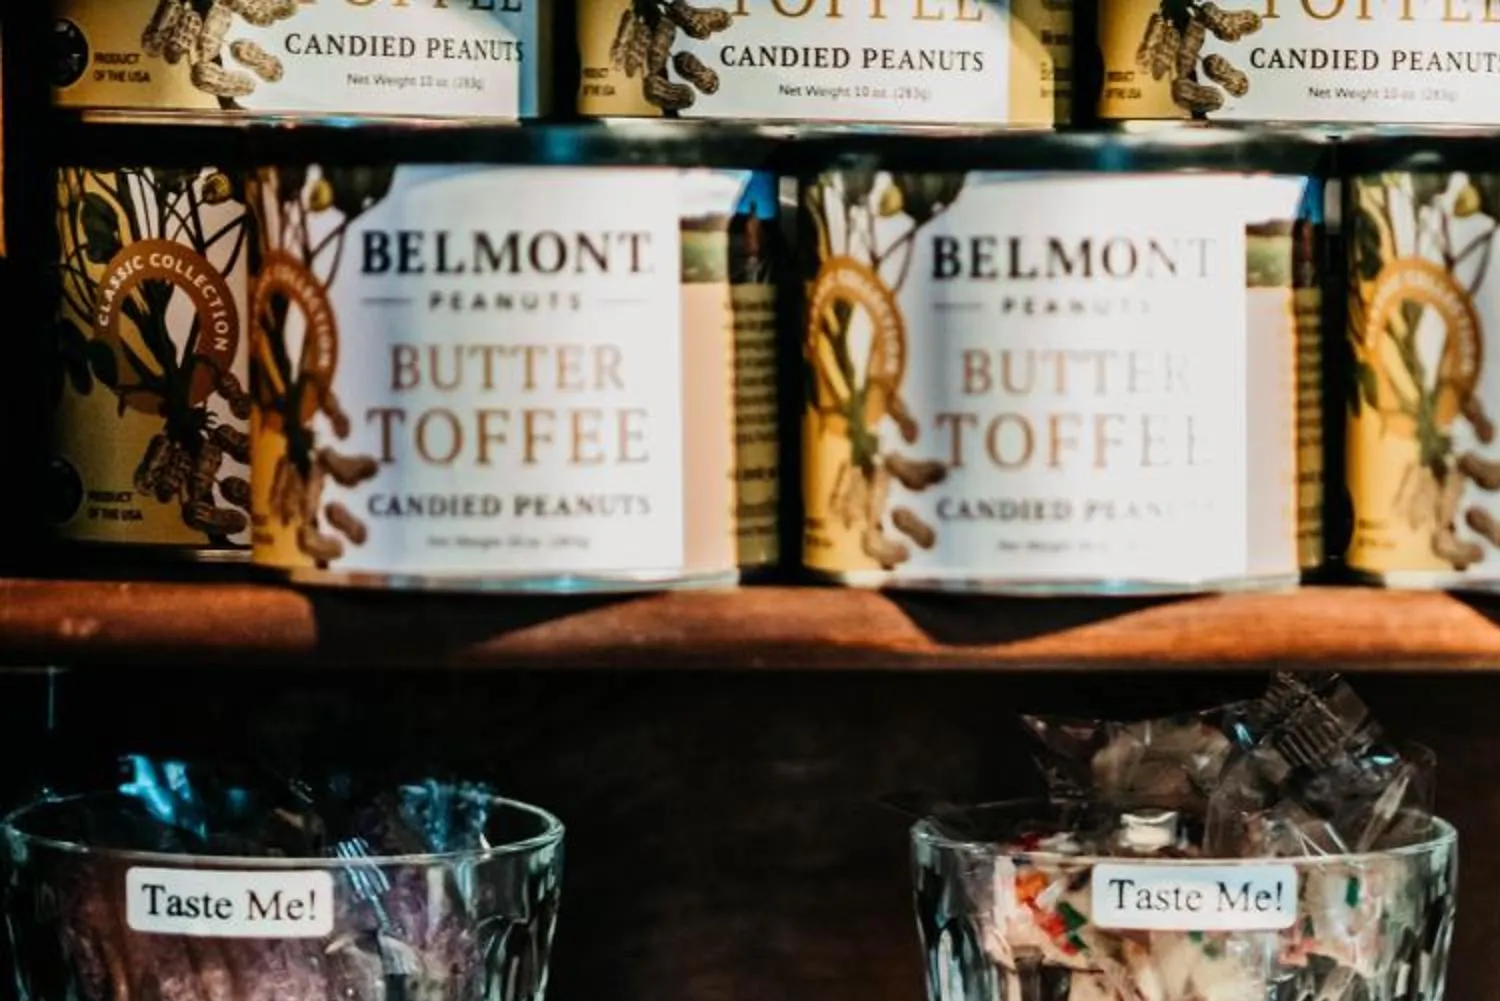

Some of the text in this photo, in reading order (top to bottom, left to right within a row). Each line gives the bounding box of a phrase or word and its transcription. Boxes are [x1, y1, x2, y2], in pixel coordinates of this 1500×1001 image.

[284, 33, 524, 63] CANDIED PEANUTS
[720, 46, 984, 72] CANDIED PEANUTS
[1250, 48, 1379, 71] CANDIED
[361, 230, 653, 276] BELMONT
[930, 235, 1217, 282] BELMONT
[98, 253, 146, 327] CLASSIC
[148, 251, 230, 352] COLLECTION
[428, 292, 582, 312] PEANUTS
[389, 343, 626, 393] BUTTER
[365, 408, 651, 467] TOFFEE
[367, 493, 652, 518] CANDIED PEANUTS
[935, 496, 1074, 522] CANDIED
[141, 883, 318, 922] Taste Me!
[1108, 879, 1286, 913] Taste Me!
